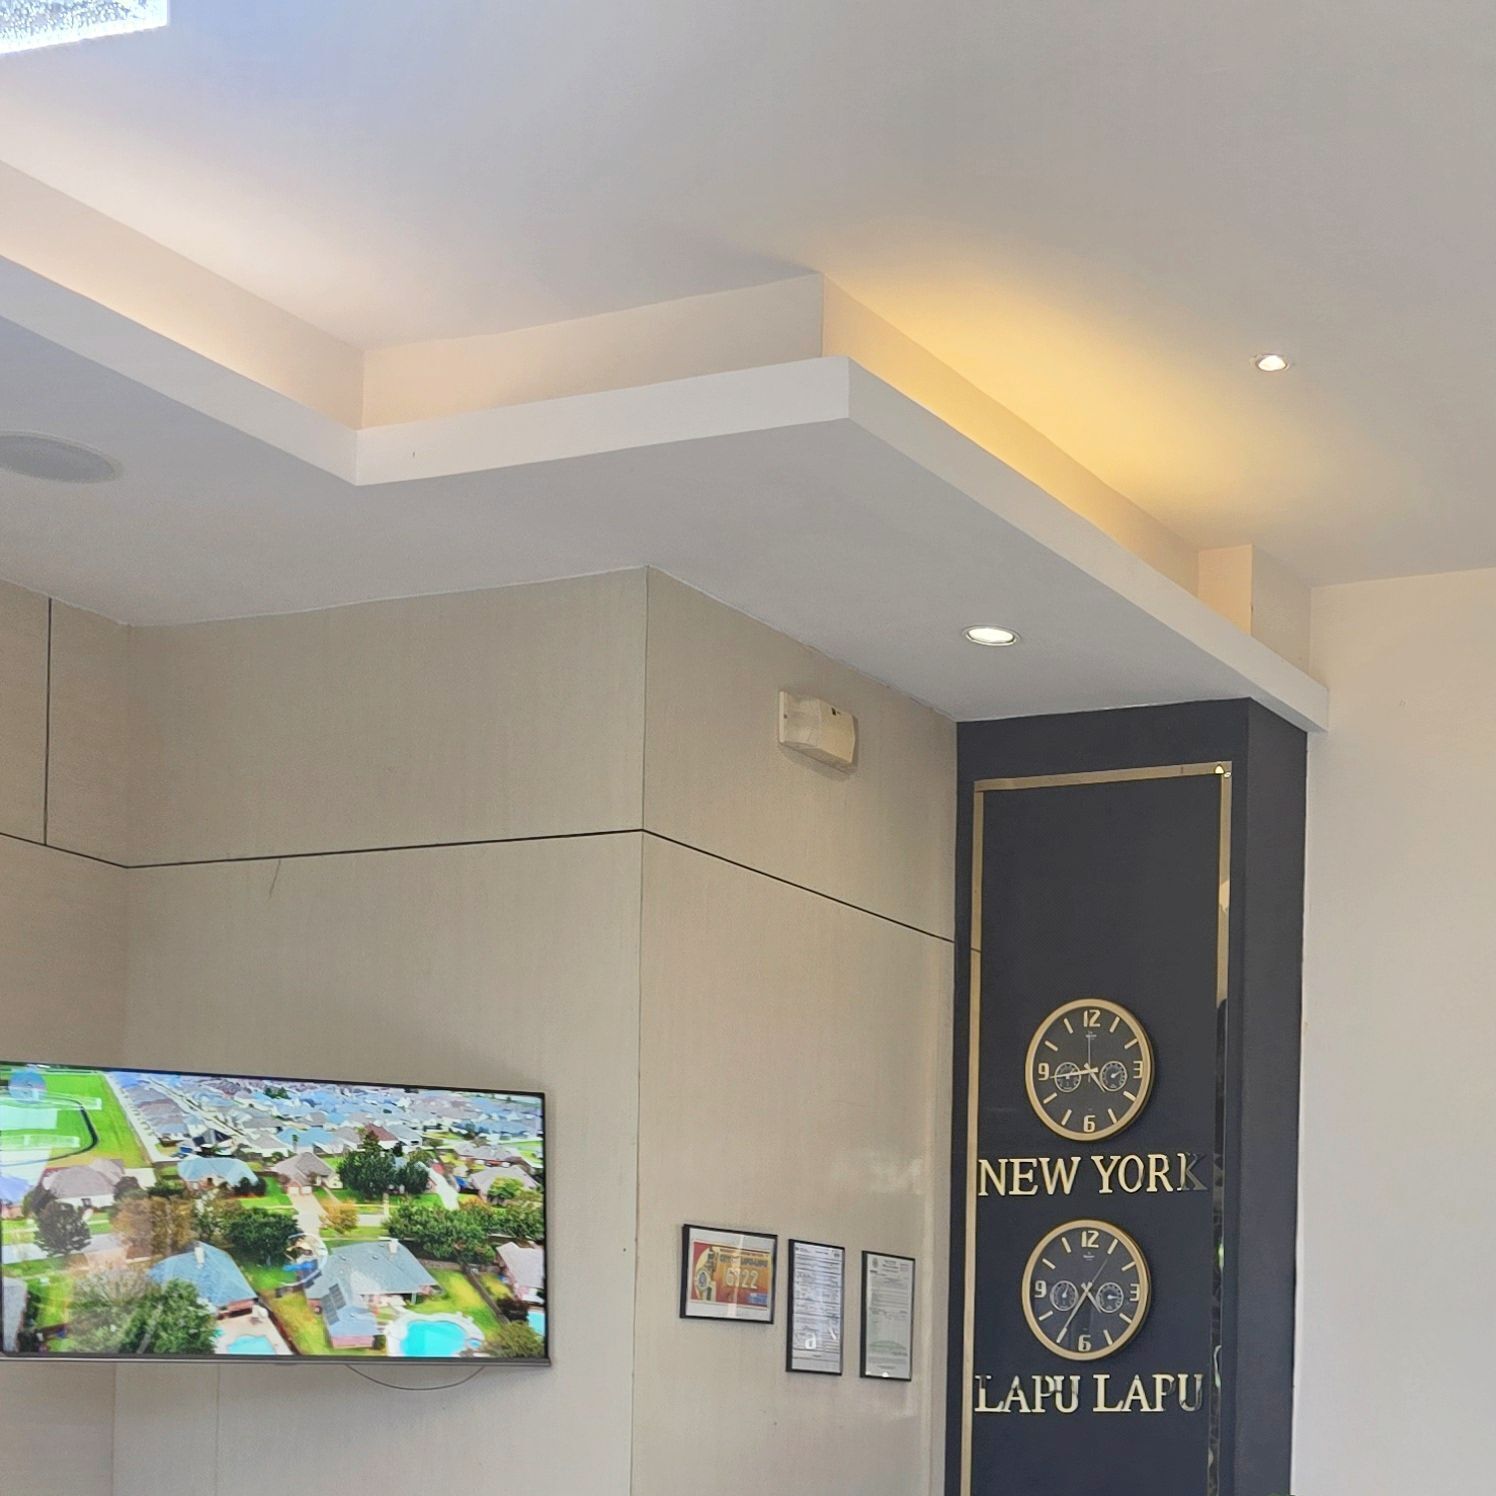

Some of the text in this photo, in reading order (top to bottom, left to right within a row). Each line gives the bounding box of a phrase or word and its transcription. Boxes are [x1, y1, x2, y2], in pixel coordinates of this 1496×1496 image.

[1083, 1009, 1101, 1027] 12
[1038, 1063, 1050, 1081] 9
[1133, 1060, 1143, 1079] 3
[1083, 1114, 1096, 1132] 6
[977, 1152, 1209, 1196] NEW YORK
[1081, 1230, 1099, 1248] 12
[1035, 1280, 1047, 1298] 9
[1130, 1283, 1140, 1302] 3
[1078, 1334, 1092, 1352] 6
[974, 1373, 1204, 1413] LAPU LAPU
